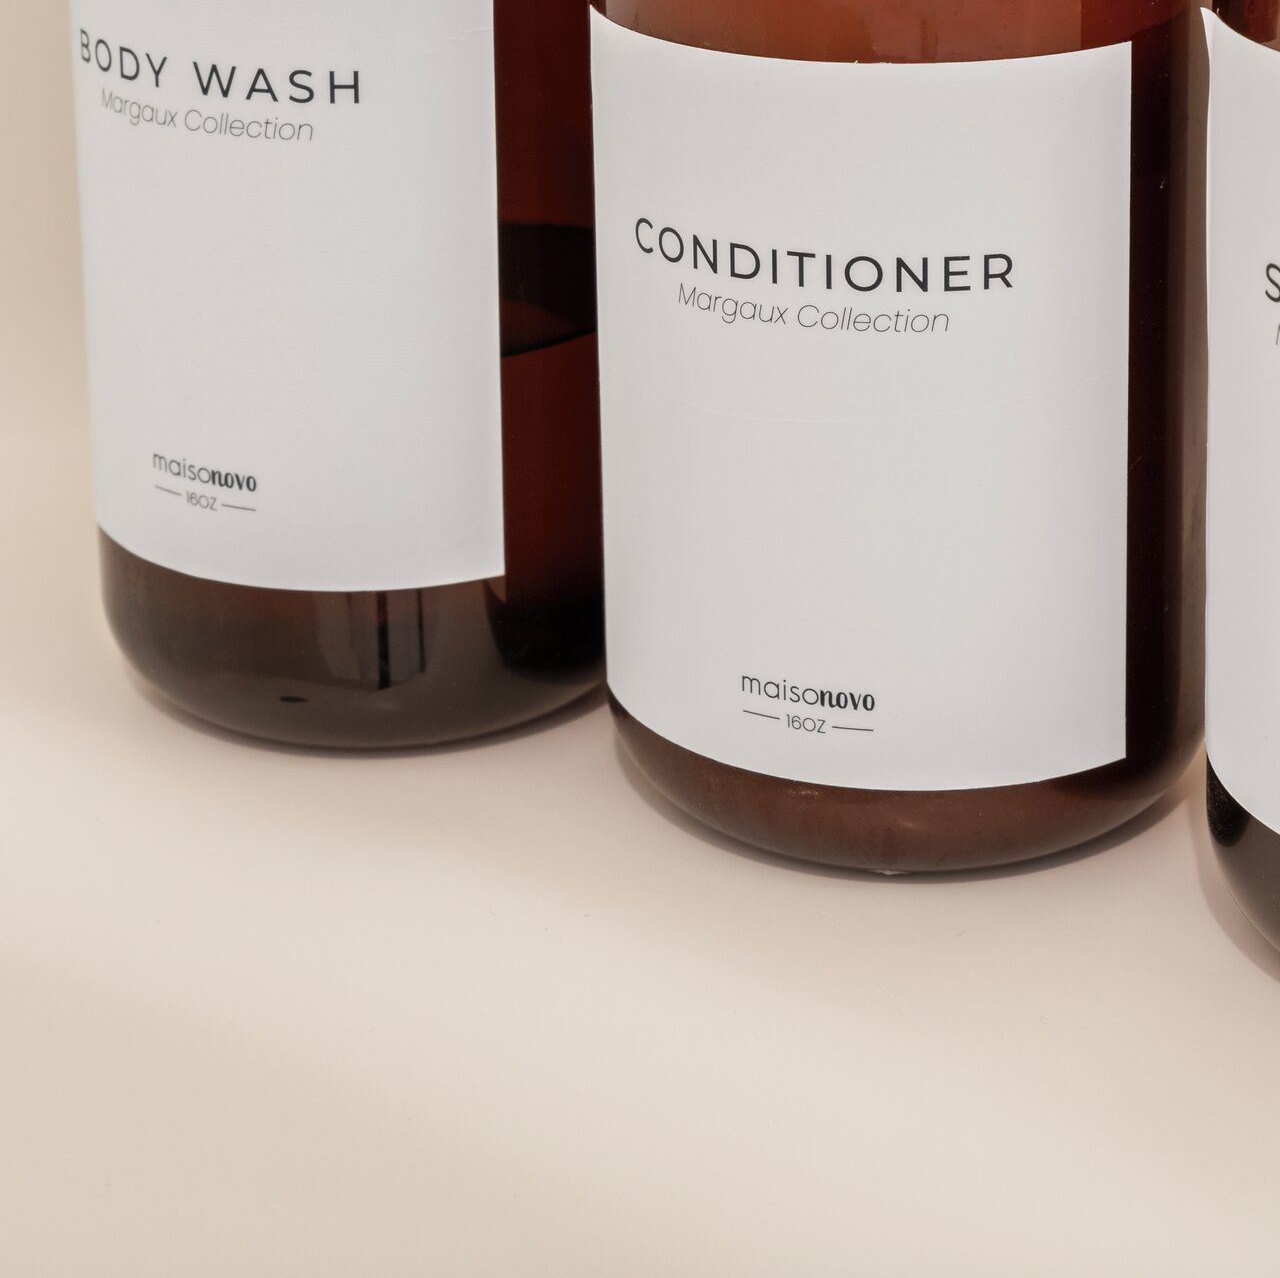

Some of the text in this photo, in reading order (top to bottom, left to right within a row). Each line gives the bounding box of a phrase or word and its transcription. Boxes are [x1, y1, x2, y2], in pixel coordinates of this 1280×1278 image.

[79, 28, 361, 105] BODY WASH
[101, 87, 315, 142] Margaux Collection
[634, 217, 1014, 294] CONDITIONER
[678, 282, 950, 333] Margaux Collection
[152, 452, 258, 493] maisonovo
[741, 674, 876, 712] maisonovo
